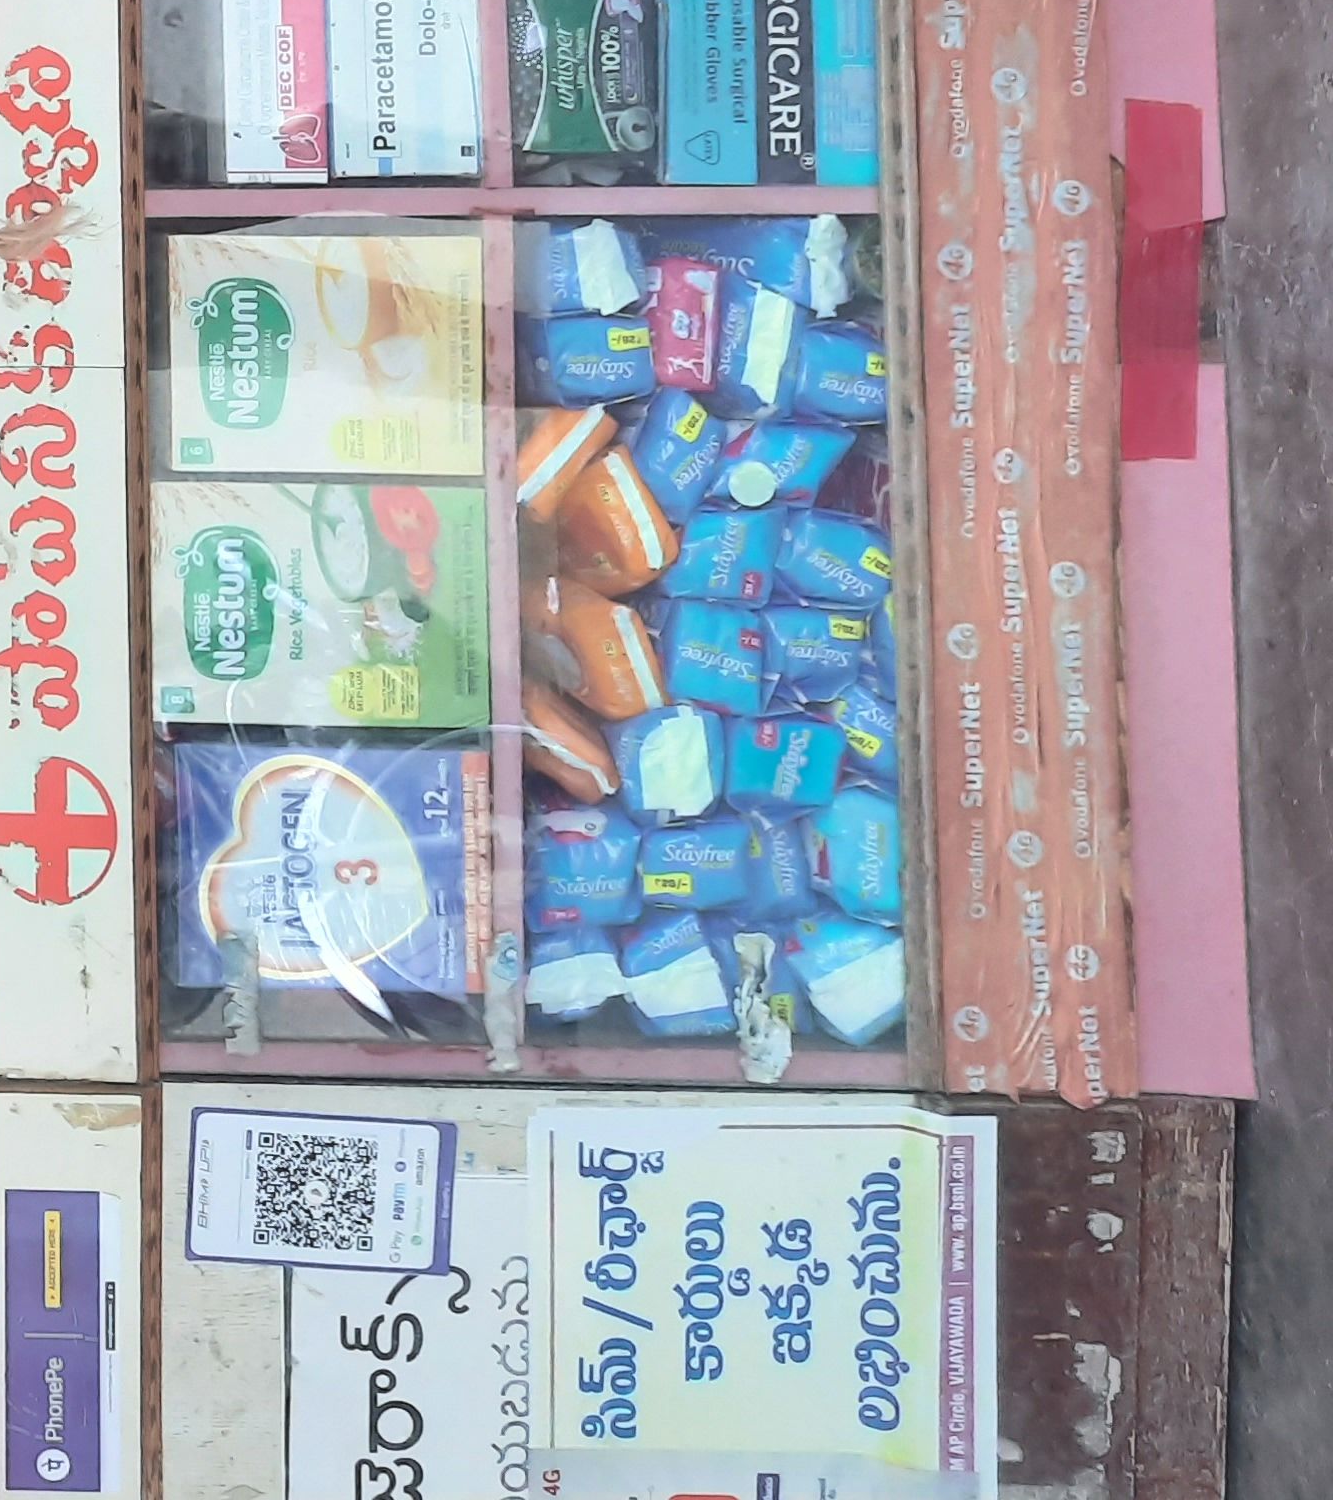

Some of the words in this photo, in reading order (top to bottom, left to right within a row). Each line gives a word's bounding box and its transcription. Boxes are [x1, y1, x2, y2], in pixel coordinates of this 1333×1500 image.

[278, 28, 292, 65] COF
[575, 27, 586, 59] Nights
[601, 25, 621, 72] 100%
[279, 71, 293, 107] DEC
[550, 24, 575, 110] whisper
[705, 46, 720, 103] Gloves
[731, 57, 749, 125] Surgical
[942, 248, 971, 277] 4G
[227, 289, 261, 424] Nestum
[303, 341, 318, 372] Rice
[565, 361, 635, 378] Stayfree
[949, 305, 977, 429] SuperNet
[189, 445, 204, 456] 6
[957, 437, 976, 521] vodafone
[709, 515, 739, 585] Stayfree
[995, 507, 1025, 633] SuperNet
[287, 547, 308, 625] Vegetables
[1053, 563, 1080, 595] 4G
[212, 538, 247, 676] Nestum
[289, 629, 303, 660] Rice
[677, 645, 754, 679] Stayfree
[1010, 642, 1027, 727] vodafone
[1059, 621, 1087, 748] SuperNet
[423, 789, 450, 819] 12
[1072, 756, 1092, 840] vodafone
[280, 788, 320, 948] LACTOGEN
[333, 858, 379, 886] 3
[661, 843, 737, 863] Stayfree
[860, 819, 885, 896] Stayfree
[415, 1147, 427, 1186] amazon
[197, 1183, 210, 1229] BHIM
[389, 1230, 405, 1250] Pay
[389, 1251, 402, 1263] G
[951, 1234, 965, 1272] www.
[47, 1251, 57, 1291] ACCEPTED
[673, 1199, 751, 1382] కార్డులు
[759, 1217, 831, 1364] ఇక్కడ
[847, 1156, 911, 1431] లభించును.
[948, 1295, 965, 1385] VIJAYAWADA
[44, 1357, 65, 1443] PhonePe
[948, 1388, 967, 1432] Circle,
[950, 1436, 965, 1454] AP
[542, 1469, 561, 1496] 4G
